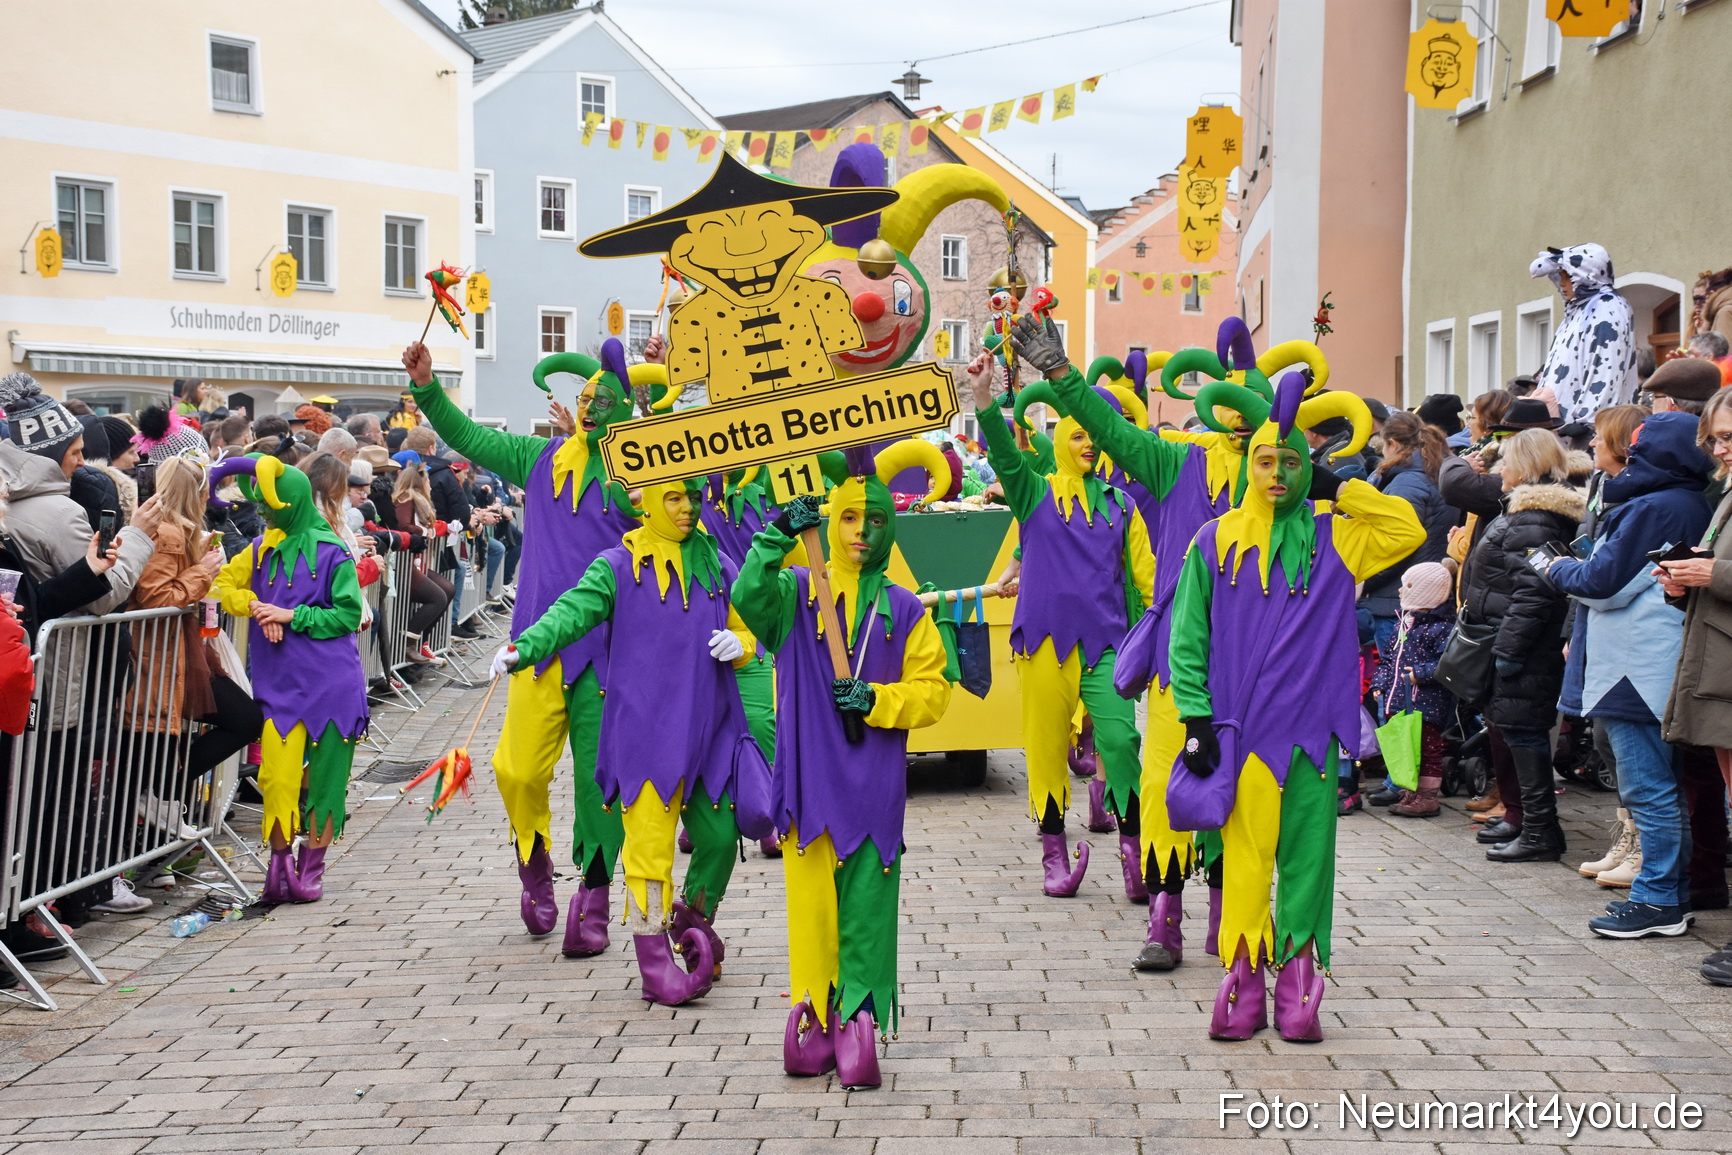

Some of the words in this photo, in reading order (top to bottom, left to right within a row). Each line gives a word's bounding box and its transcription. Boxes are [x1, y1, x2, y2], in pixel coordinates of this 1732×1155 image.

[1194, 155, 1206, 168] 人
[170, 306, 263, 333] Schuhmoden
[268, 314, 340, 341] Döllinger
[620, 422, 774, 472] Snehotta
[781, 387, 943, 442] Berching
[778, 464, 815, 497] 11
